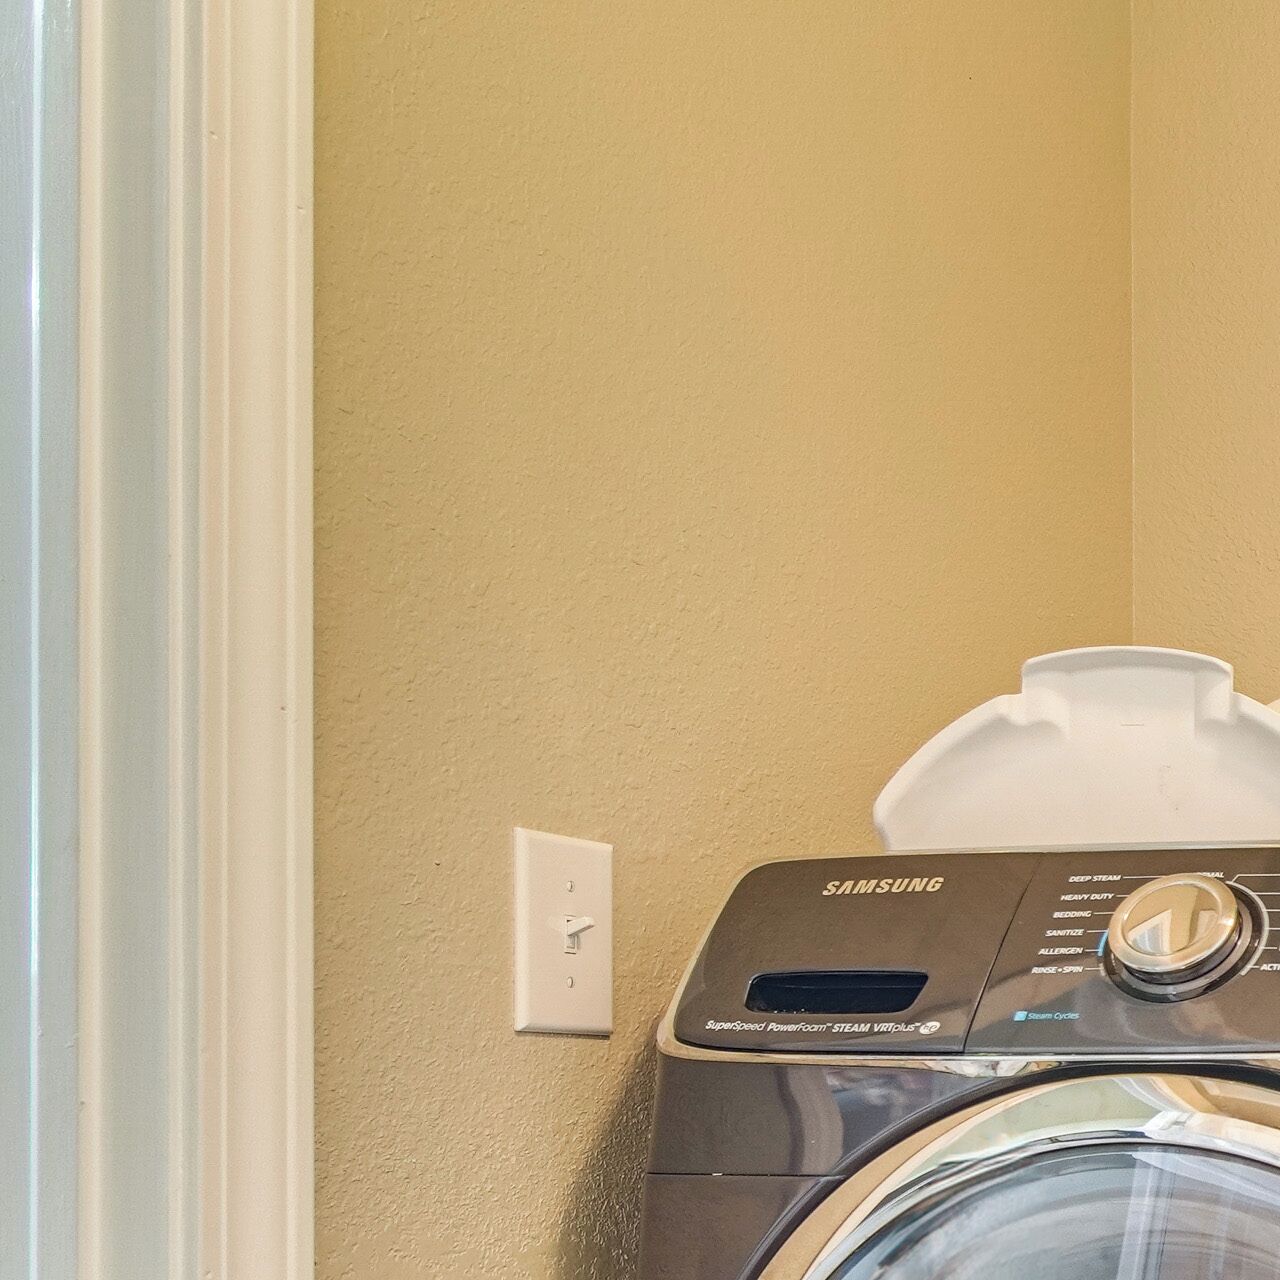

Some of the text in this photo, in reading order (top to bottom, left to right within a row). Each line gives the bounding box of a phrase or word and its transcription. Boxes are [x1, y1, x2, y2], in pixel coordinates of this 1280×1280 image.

[1069, 874, 1122, 883] DEEP STEAM
[822, 877, 944, 896] SAMSUNG
[1060, 893, 1090, 901] HEAVY
[1045, 929, 1085, 937] SANITIZE
[1038, 947, 1084, 955] ALLERGEN
[1028, 1012, 1080, 1020] Steam Cycles
[706, 1020, 766, 1031] SuperSpeed
[832, 1023, 871, 1033] STEAM
